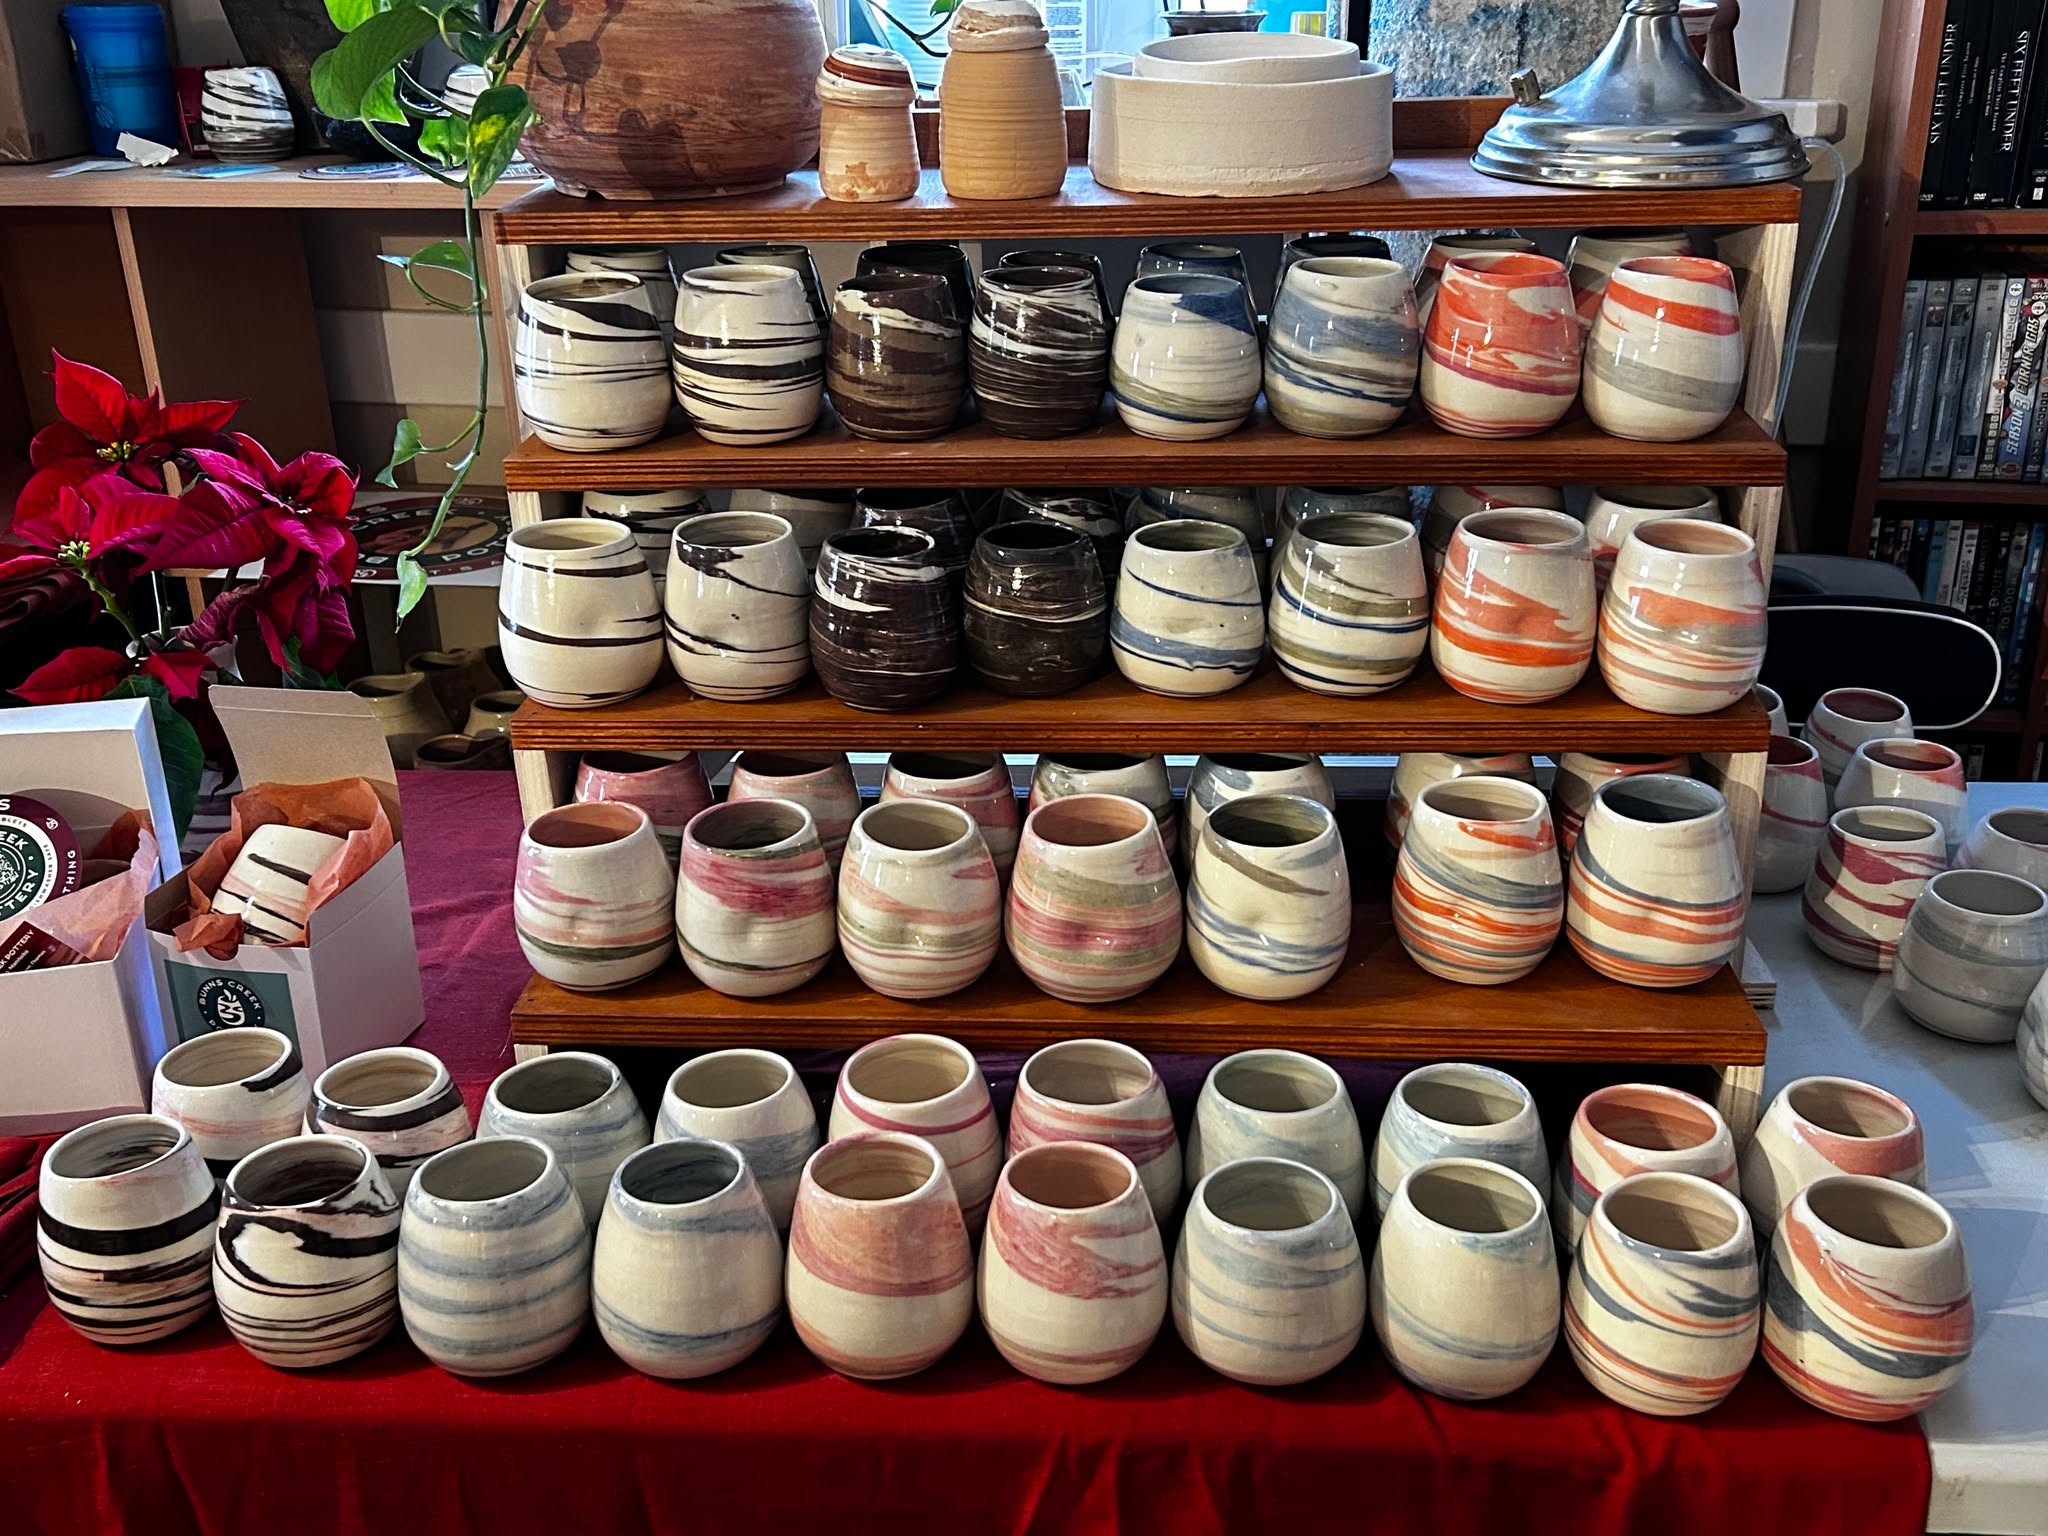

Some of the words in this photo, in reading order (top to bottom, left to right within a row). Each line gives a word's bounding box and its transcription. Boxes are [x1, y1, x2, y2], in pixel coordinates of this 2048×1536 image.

[1940, 24, 1958, 75] UNDER
[2014, 31, 2028, 54] SIX
[2007, 60, 2024, 96] FEET
[1934, 79, 1949, 115] FEET
[1930, 121, 1944, 143] SIX
[2000, 101, 2018, 151] UNDER
[2025, 315, 2040, 344] GAS
[2016, 344, 2035, 396] CORNER
[2006, 408, 2024, 455] SEASON
[62, 850, 76, 894] THING
[4, 929, 34, 960] POTTERY
[199, 979, 223, 1005] BUNNS
[227, 981, 261, 1009] CREEK
